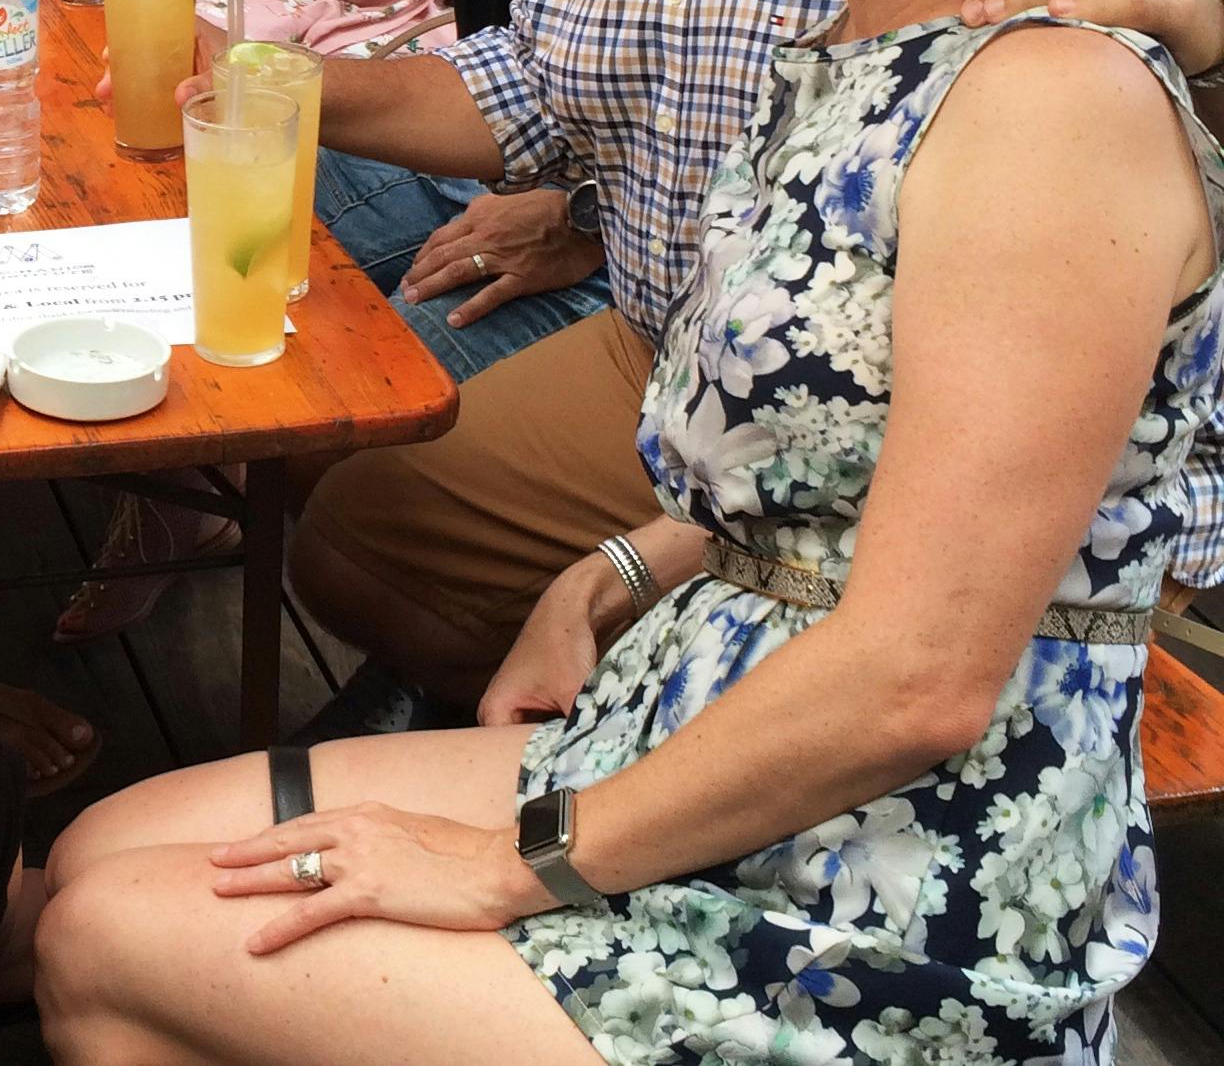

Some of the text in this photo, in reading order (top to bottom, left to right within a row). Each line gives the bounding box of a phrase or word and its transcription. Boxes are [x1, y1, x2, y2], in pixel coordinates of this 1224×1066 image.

[47, 281, 118, 292] reserved
[122, 280, 147, 289] for
[84, 296, 127, 305] from
